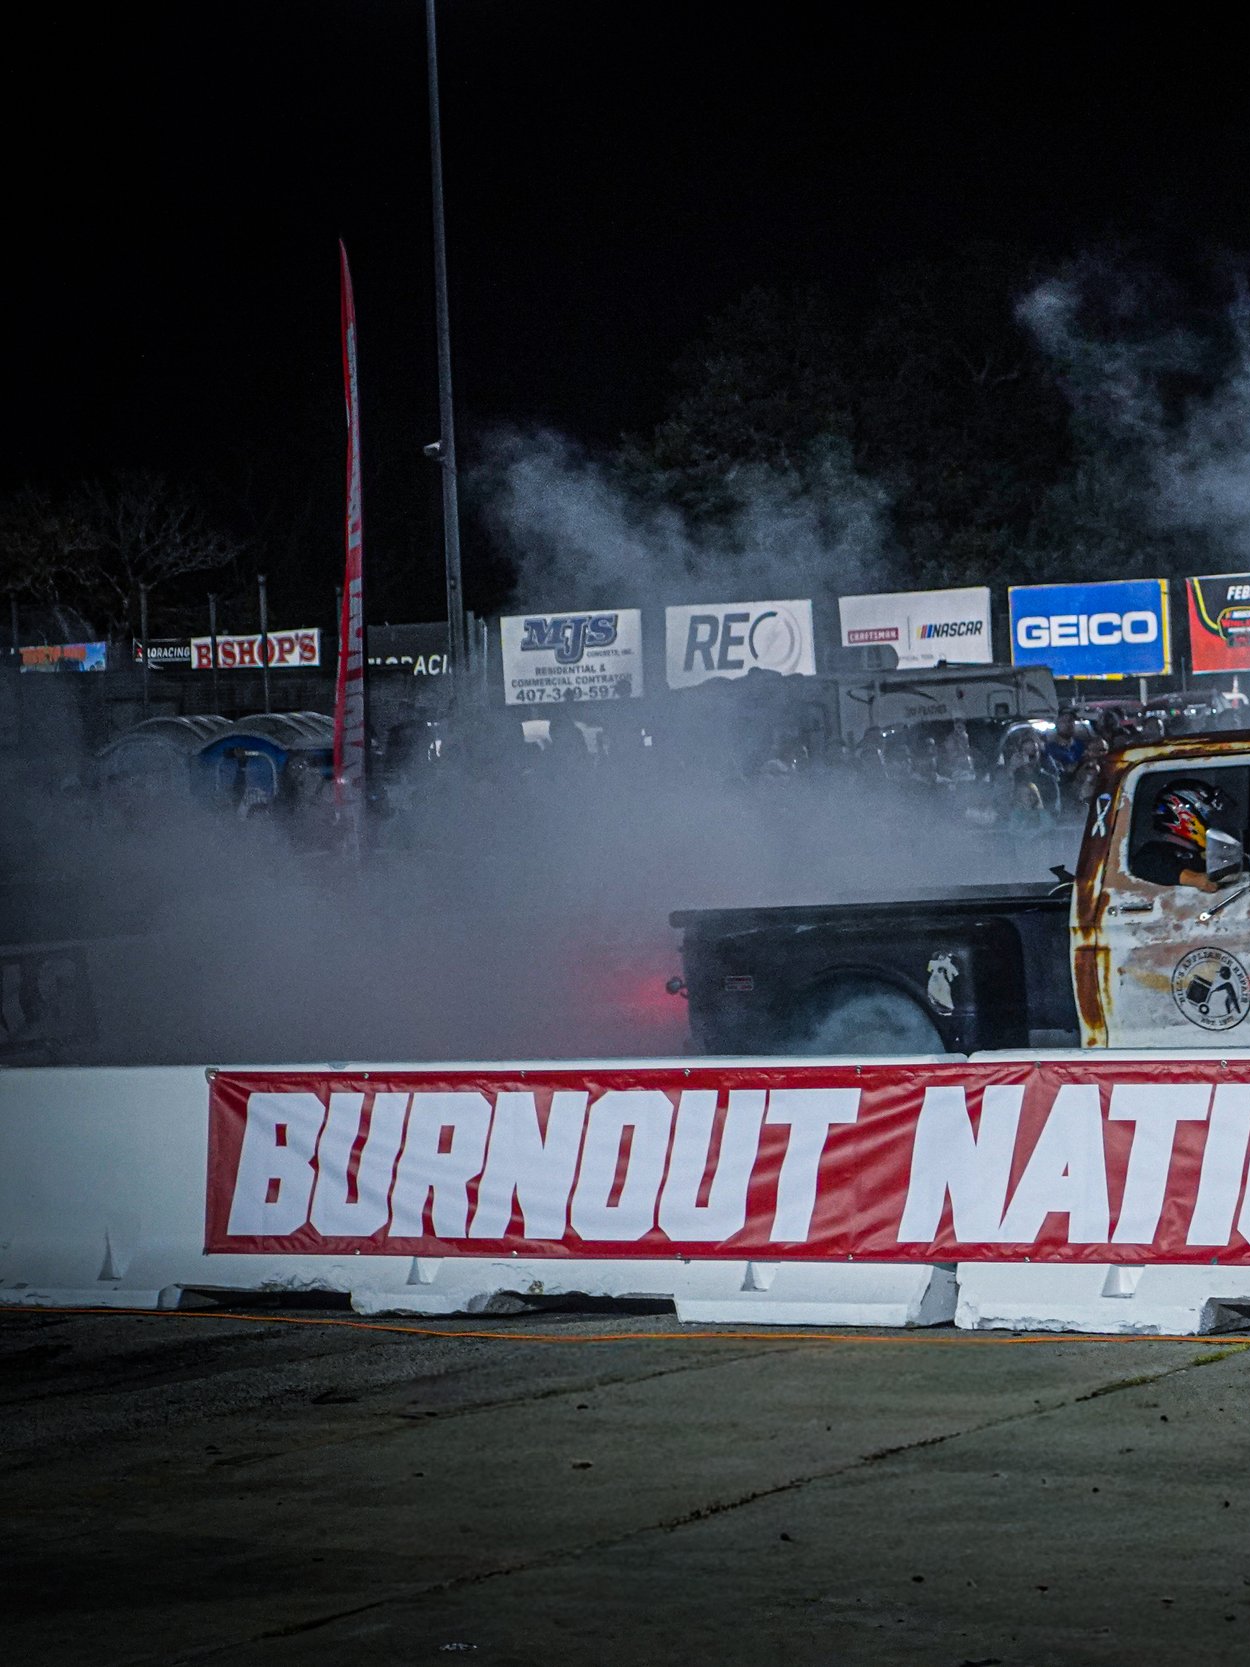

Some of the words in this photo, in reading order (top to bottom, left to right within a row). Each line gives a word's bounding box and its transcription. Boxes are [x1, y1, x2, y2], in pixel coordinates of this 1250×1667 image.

[521, 613, 618, 664] MJS
[931, 620, 983, 637] NASCAR
[1017, 612, 1158, 649] GEICO
[511, 677, 573, 688] COMMERCIAL
[535, 665, 596, 676] RESIDENTIAL
[227, 1086, 861, 1243] BURNOUT
